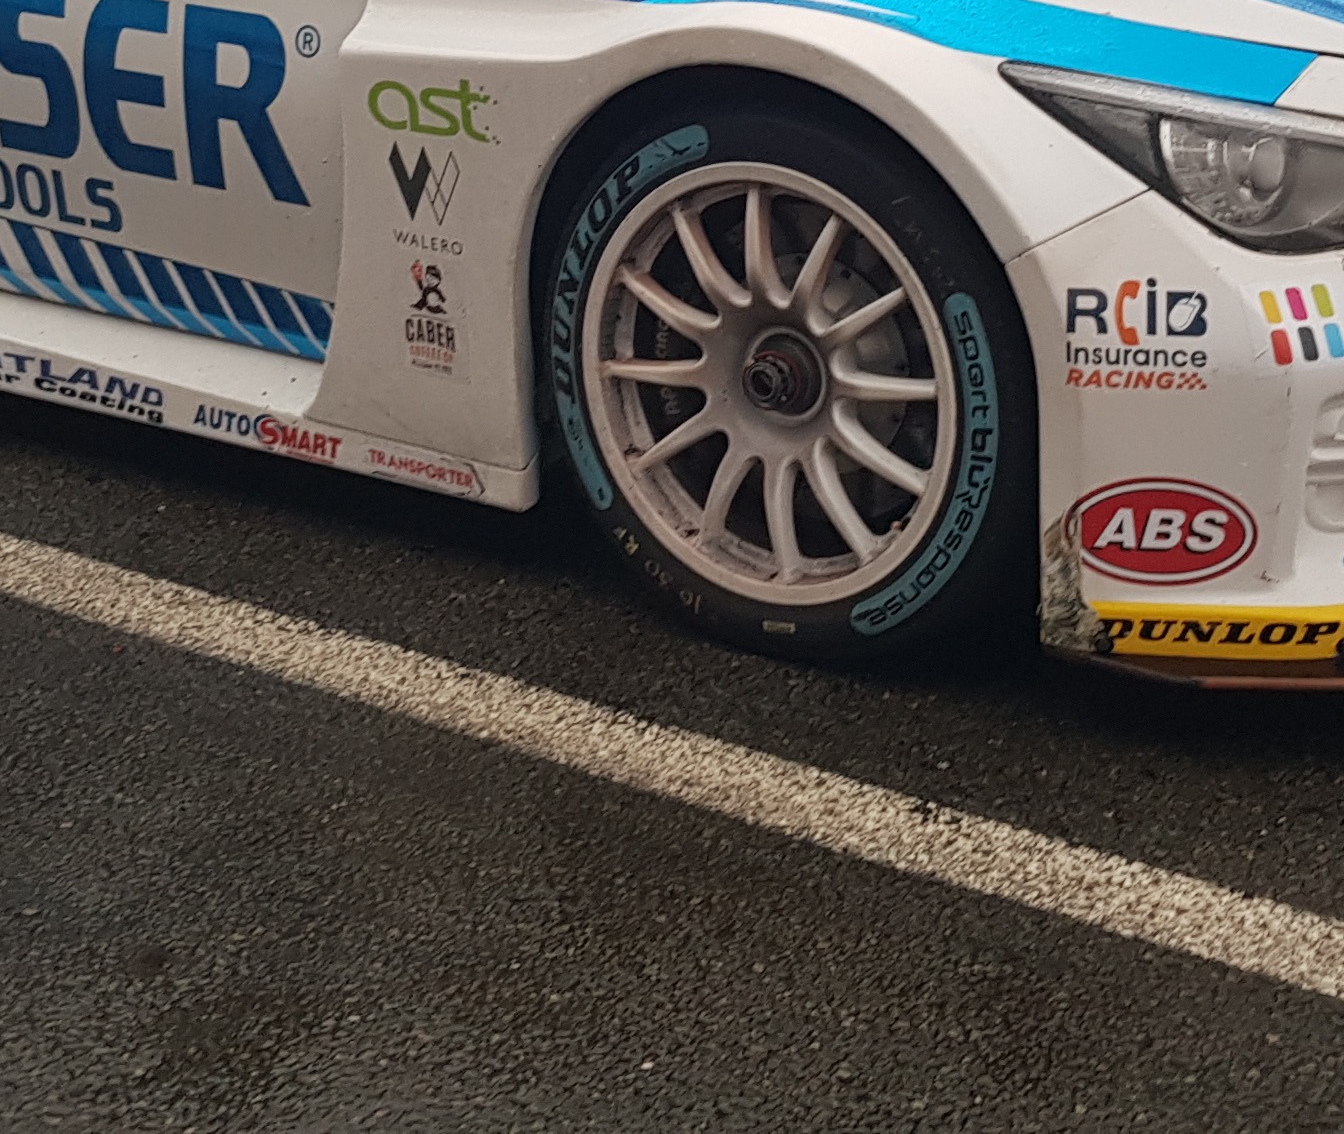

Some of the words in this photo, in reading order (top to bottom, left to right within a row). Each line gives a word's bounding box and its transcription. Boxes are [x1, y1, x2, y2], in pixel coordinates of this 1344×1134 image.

[367, 78, 492, 144] ast
[392, 228, 465, 257] WALERO
[404, 317, 457, 354] CABER
[1065, 340, 1209, 368] Insurance
[1064, 369, 1176, 391] RACING
[33, 377, 166, 425] Coating
[192, 403, 344, 460] AUTOSMART
[367, 448, 474, 489] TRANSPORTER
[1092, 507, 1231, 553] ABS
[1097, 616, 1341, 647] DUNLOP
